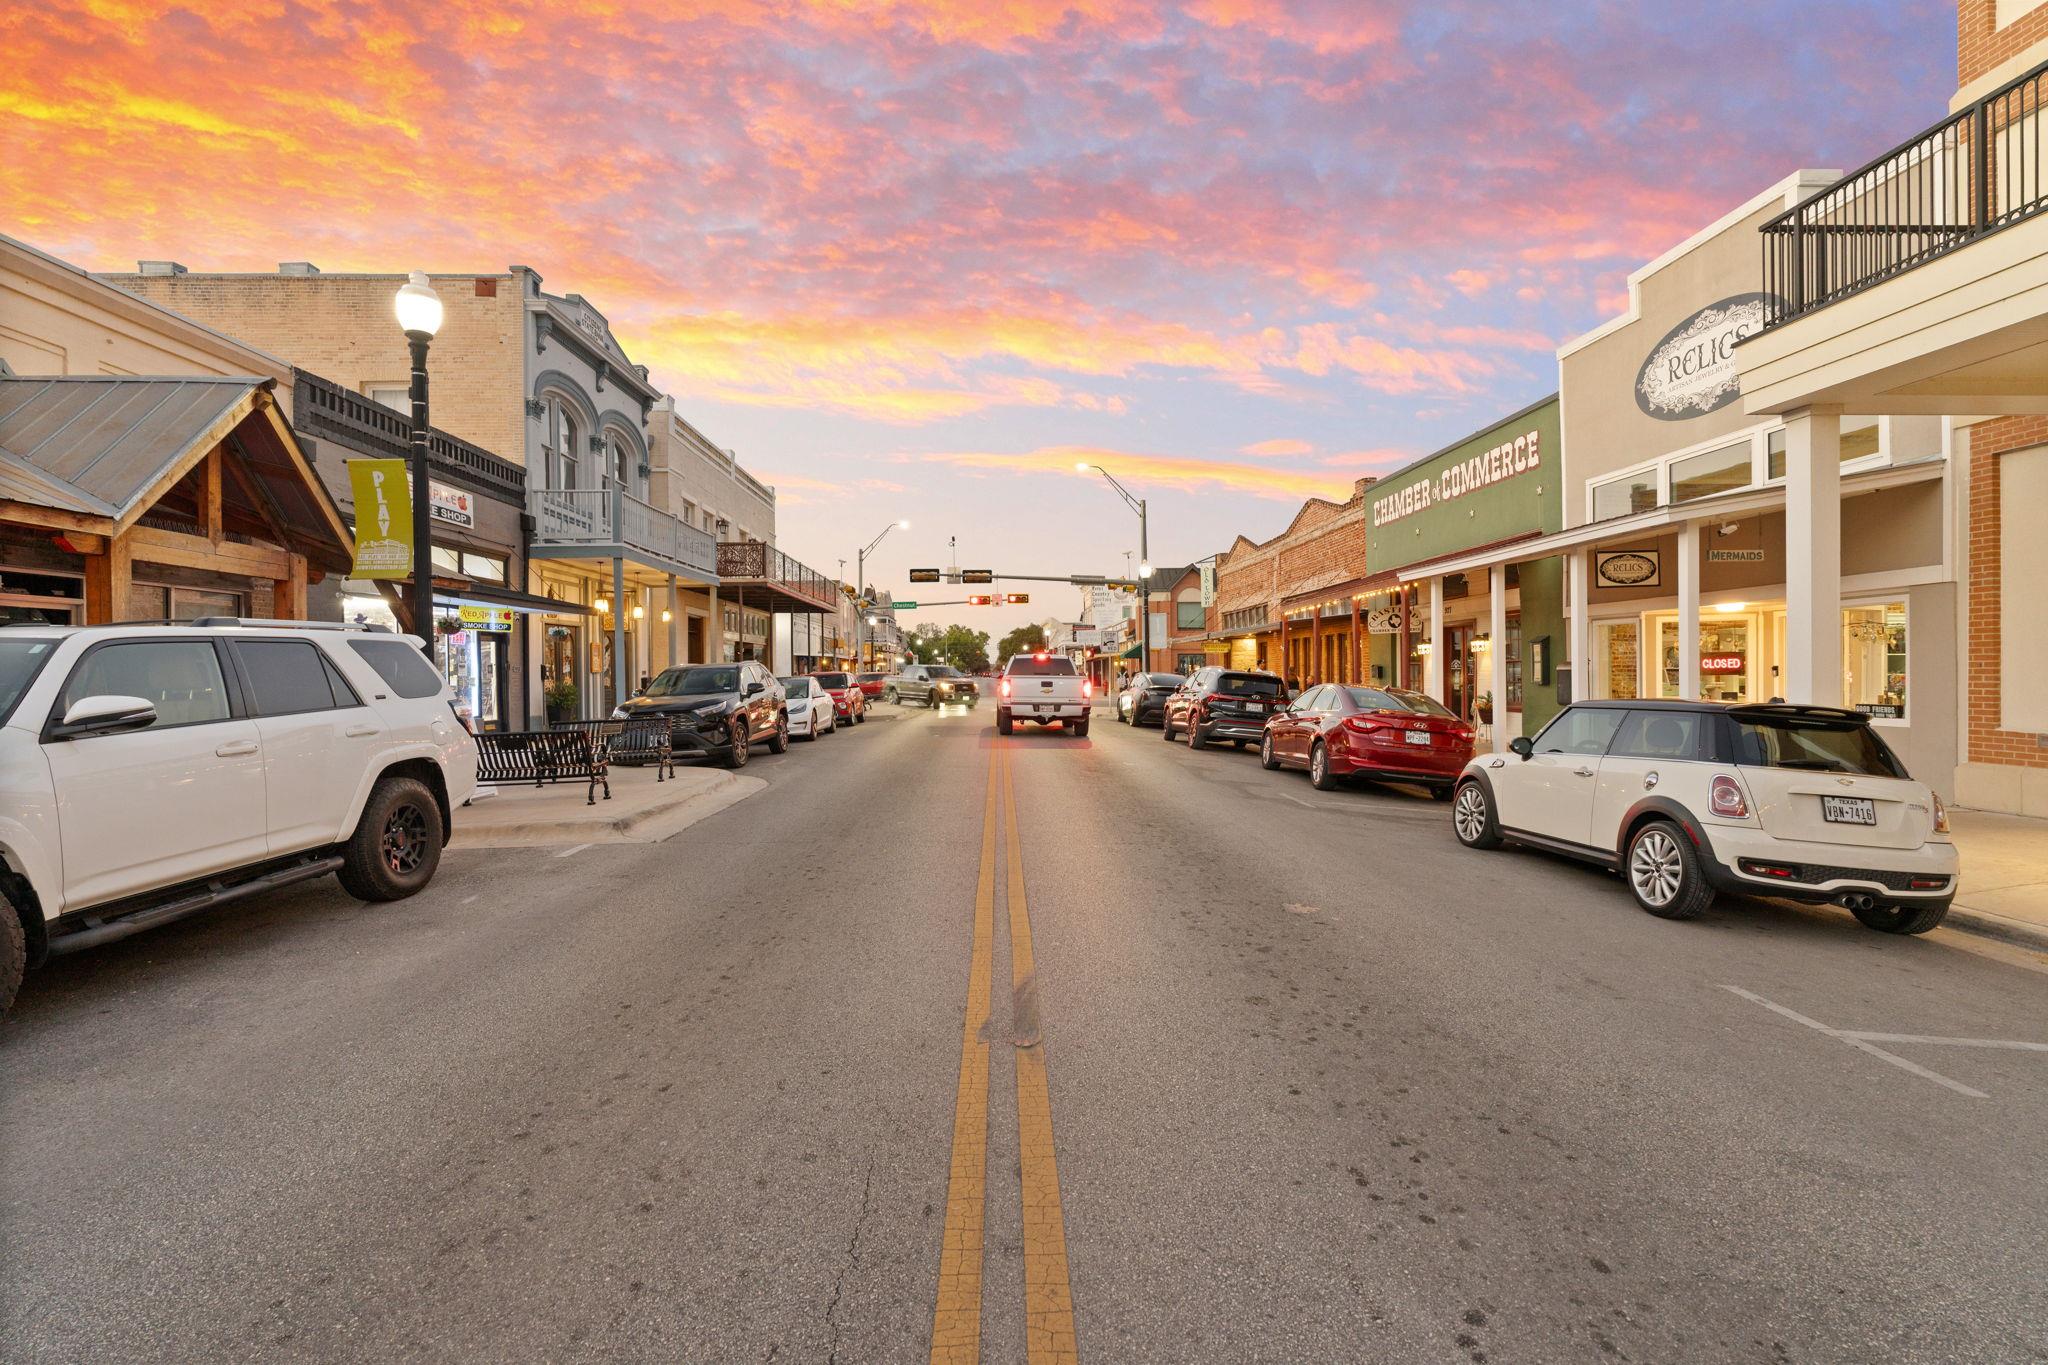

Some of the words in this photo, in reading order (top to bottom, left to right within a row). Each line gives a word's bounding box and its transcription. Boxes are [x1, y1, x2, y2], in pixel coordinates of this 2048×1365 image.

[1667, 324, 1749, 384] RELICS
[1695, 366, 1723, 381] JEWELRY
[1373, 478, 1431, 527] CHAMBER
[1432, 480, 1441, 501] of
[1441, 430, 1540, 500] COMMERCE
[372, 470, 390, 537] PLAY
[440, 507, 467, 523] SHOP
[1613, 563, 1644, 572] RELICS
[461, 609, 477, 620] RED
[463, 622, 486, 630] SMOKE
[1702, 658, 1741, 669] CLOSED
[1856, 705, 1870, 713] GOOD
[1871, 705, 1896, 714] FRIENDS
